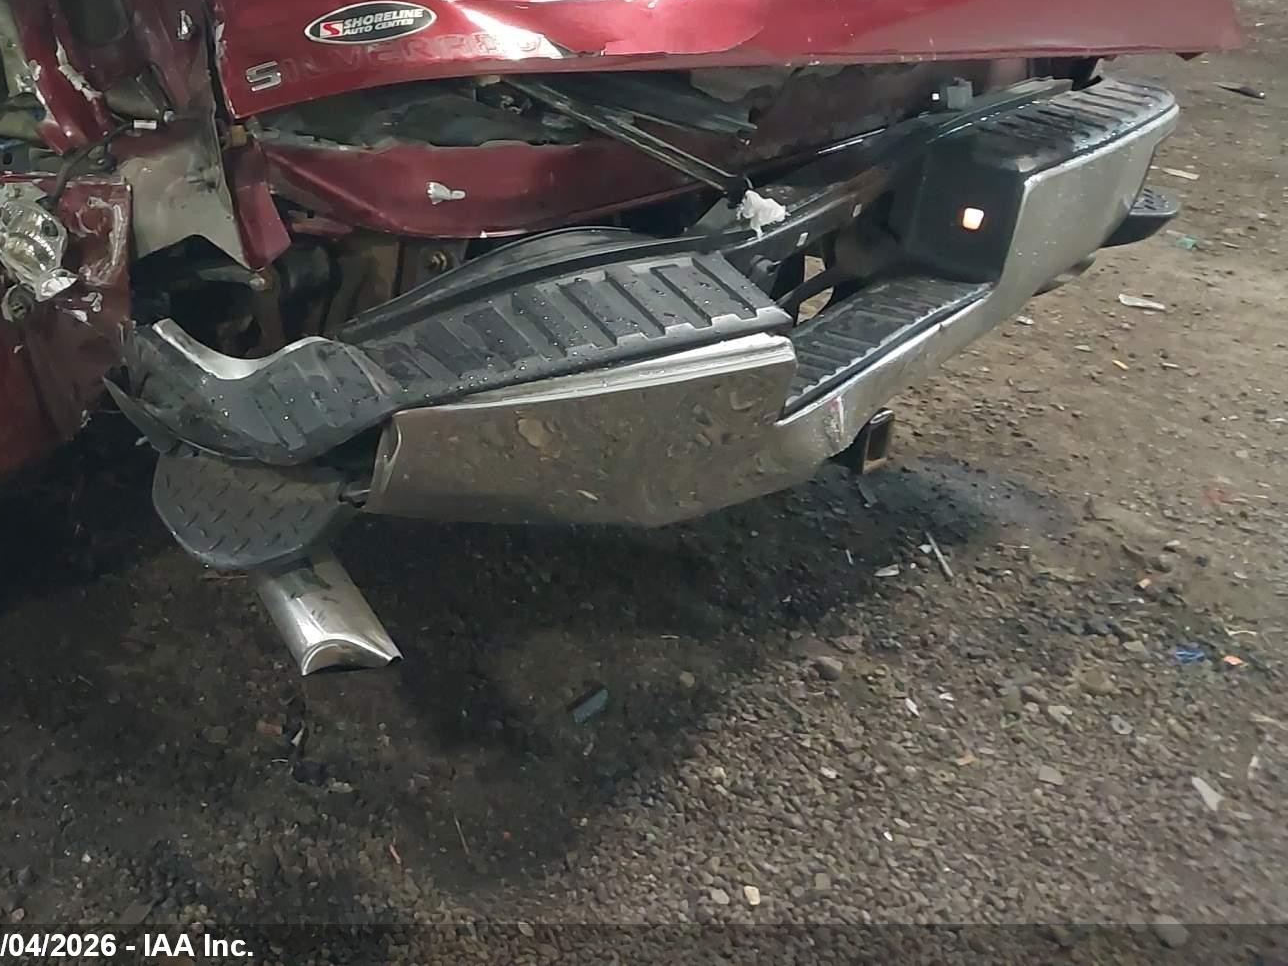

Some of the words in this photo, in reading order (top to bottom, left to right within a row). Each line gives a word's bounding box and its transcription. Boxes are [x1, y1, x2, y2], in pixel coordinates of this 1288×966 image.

[343, 9, 425, 29] SHORELINE
[343, 24, 373, 36] AUTO
[374, 18, 414, 30] CENTER
